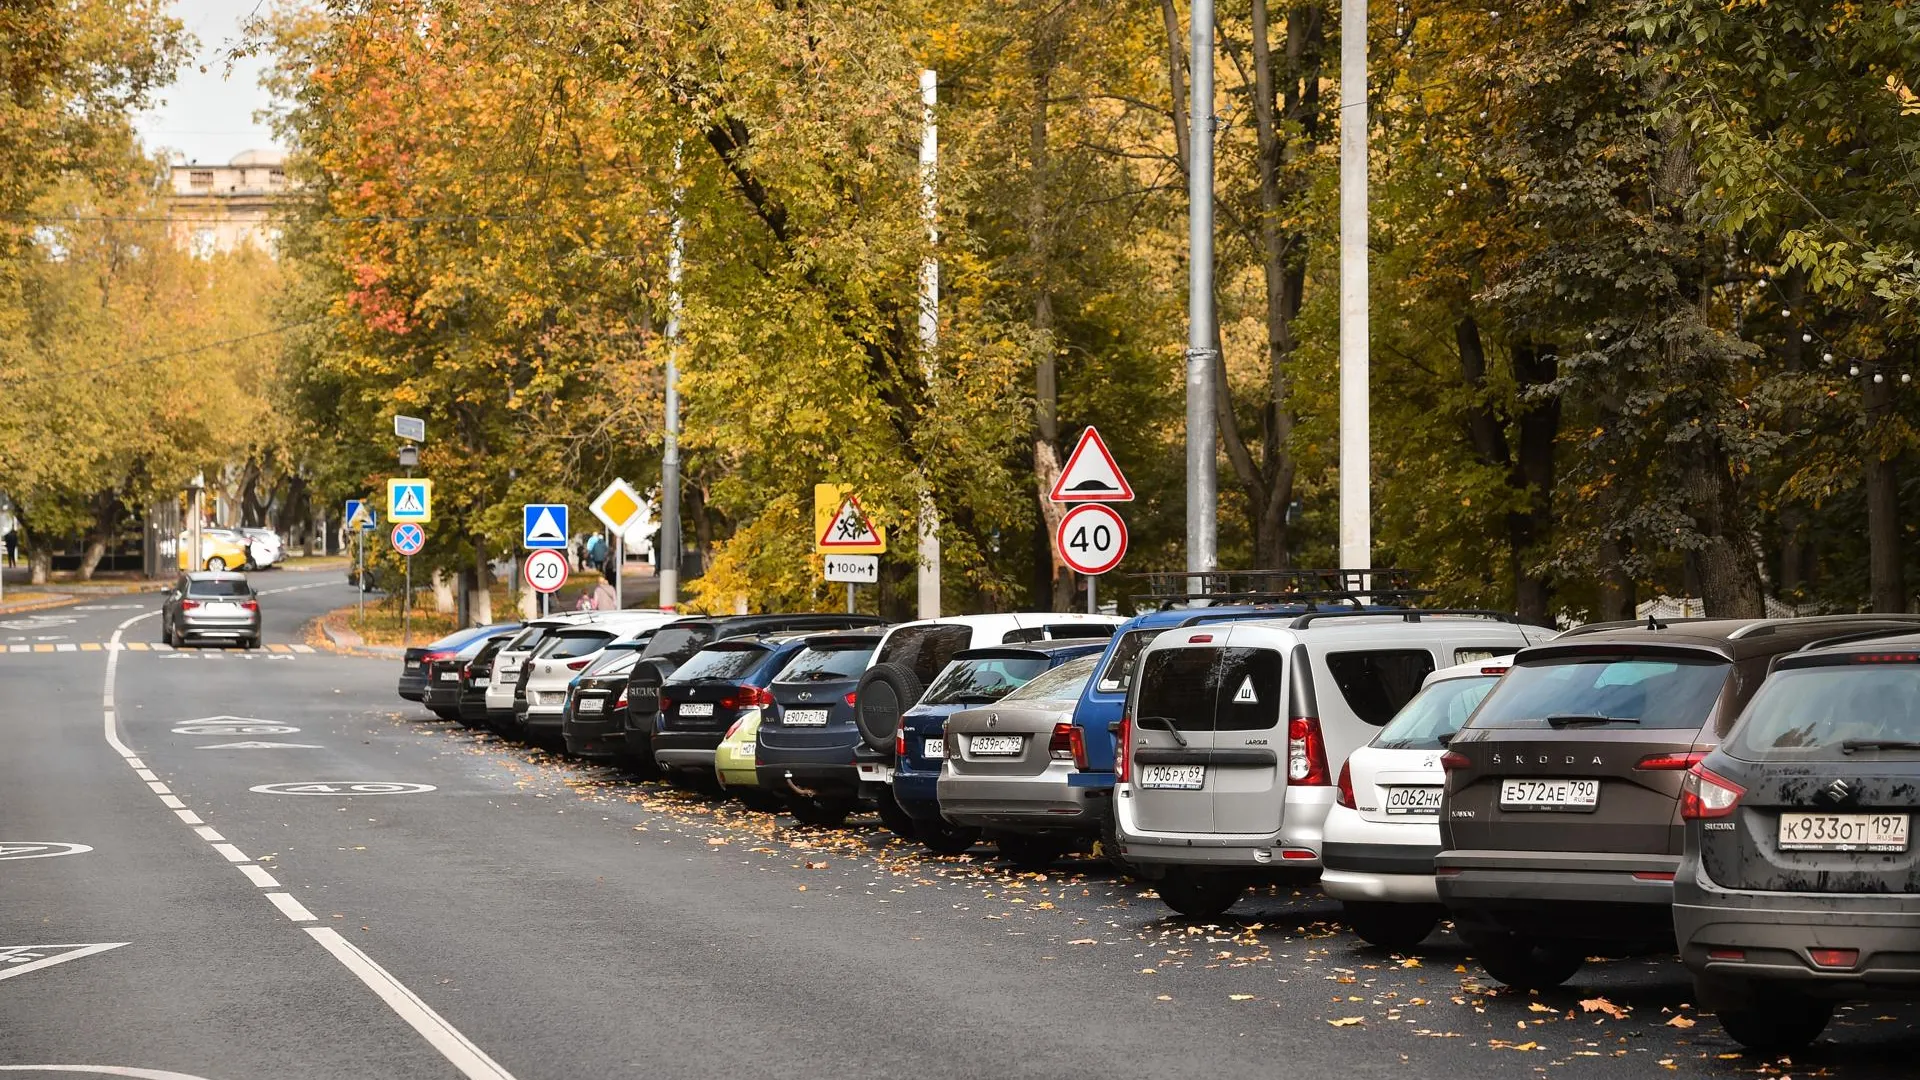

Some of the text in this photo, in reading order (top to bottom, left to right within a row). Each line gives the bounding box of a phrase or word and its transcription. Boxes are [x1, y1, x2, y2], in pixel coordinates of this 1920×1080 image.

[1069, 524, 1111, 552] 40
[535, 562, 558, 578] 20
[837, 563, 866, 574] 100м
[1241, 688, 1251, 699] Ш
[785, 711, 813, 723] Е907РС
[973, 736, 1020, 750] Н839РС 799
[1146, 766, 1200, 782] У906РХ 69
[285, 783, 404, 792] 40
[1506, 782, 1594, 802] Е572АЕ 790
[1392, 789, 1442, 806] О062НК
[1787, 816, 1902, 840] К933ОТ 197
